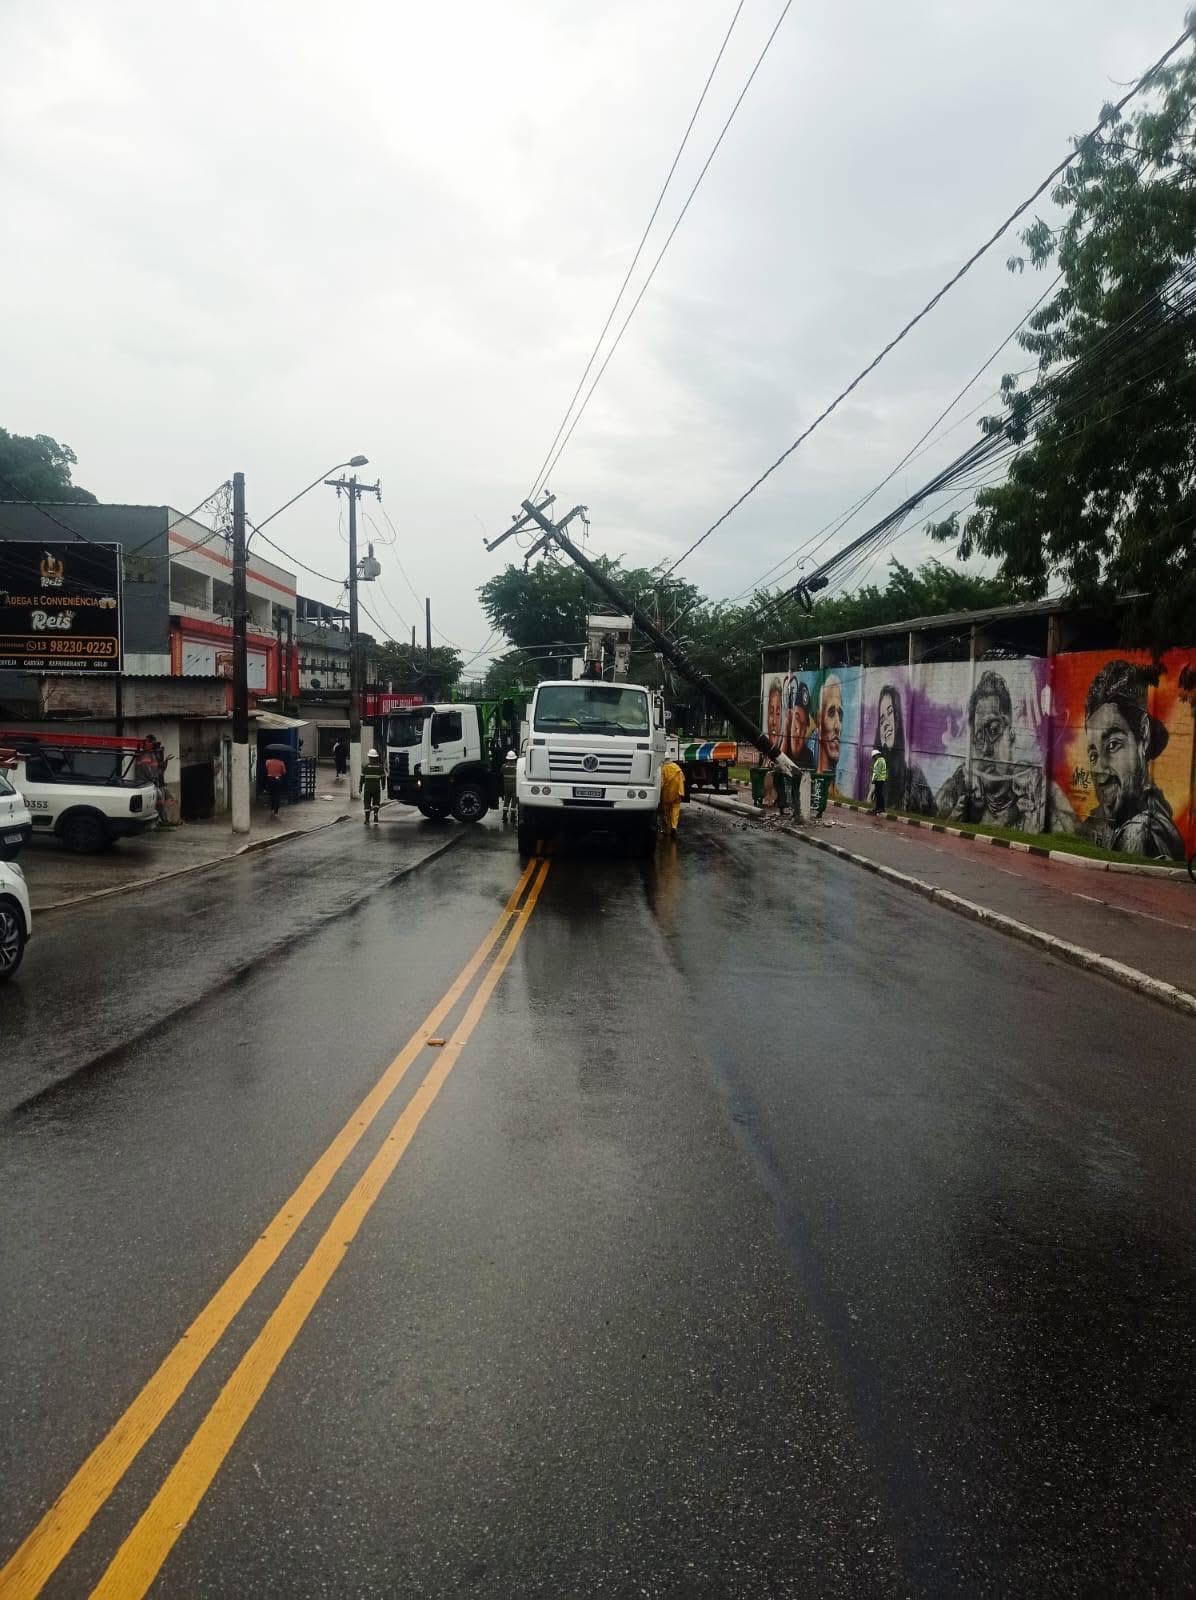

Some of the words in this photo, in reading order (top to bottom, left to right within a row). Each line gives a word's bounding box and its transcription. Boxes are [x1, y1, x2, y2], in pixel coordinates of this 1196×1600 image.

[34, 597, 39, 605] E
[31, 611, 72, 630] Reis
[37, 642, 47, 650] 13
[50, 641, 113, 654] 98230-0225
